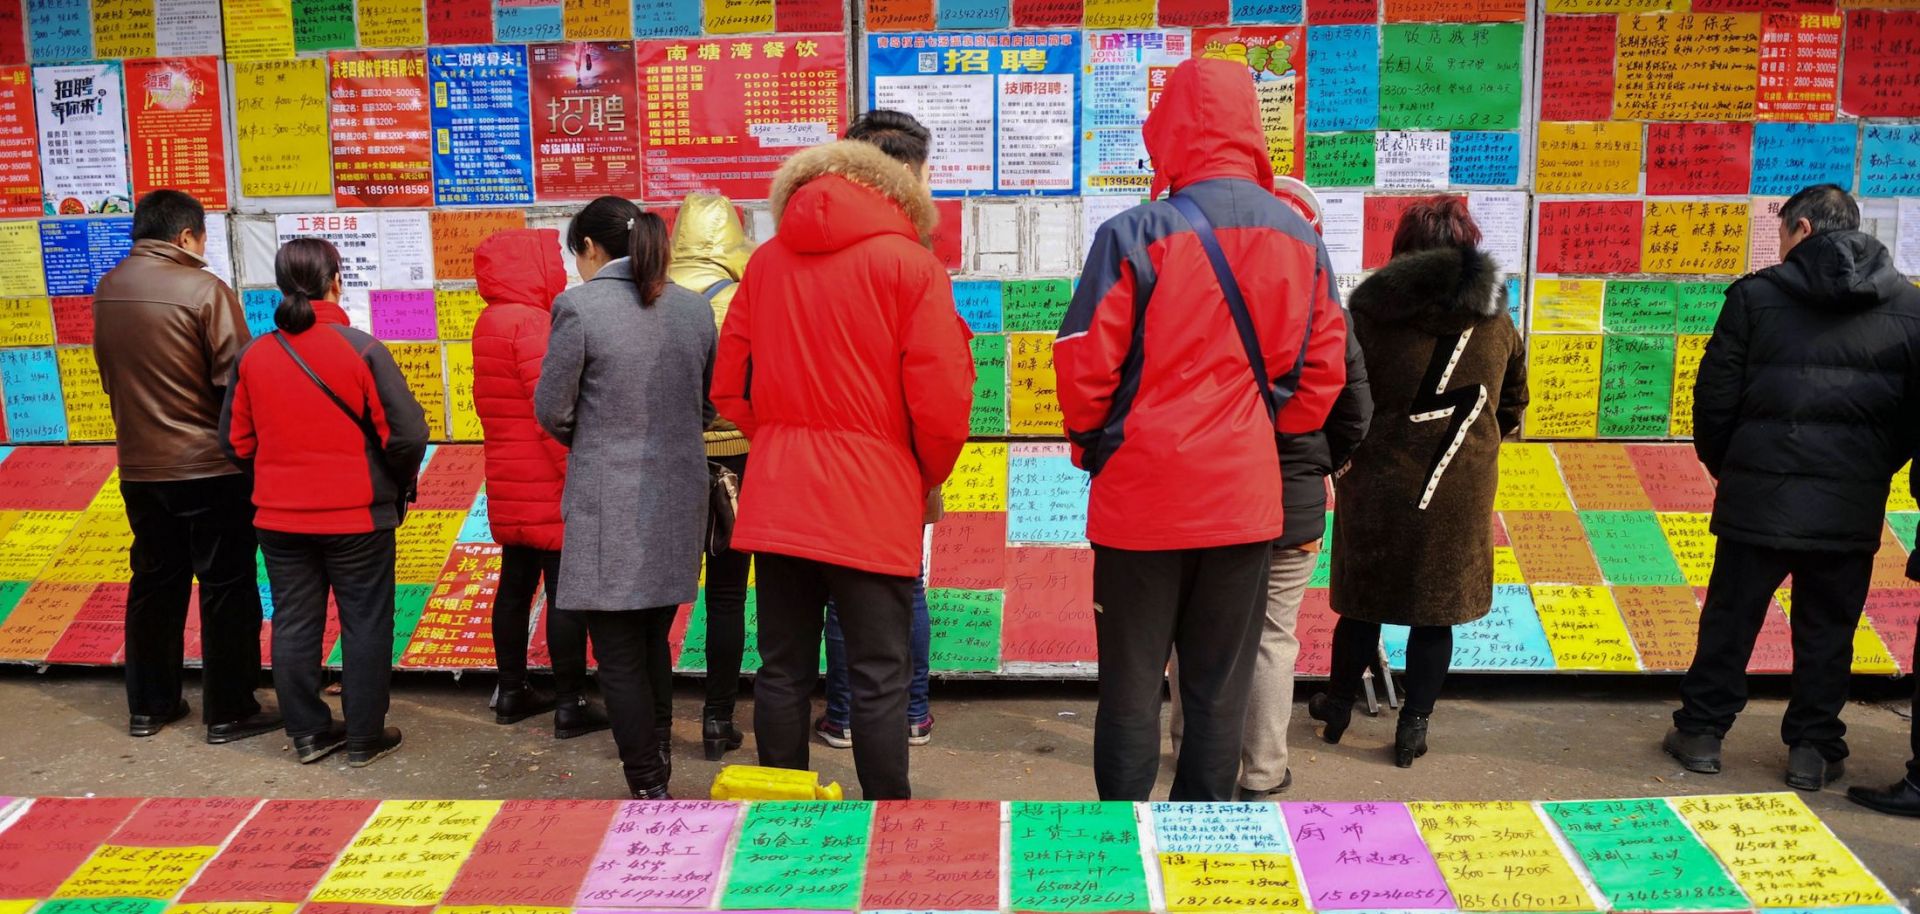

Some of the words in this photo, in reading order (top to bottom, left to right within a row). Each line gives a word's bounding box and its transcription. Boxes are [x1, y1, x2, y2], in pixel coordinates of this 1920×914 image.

[1799, 14, 1842, 29] 招聘
[664, 40, 819, 61] 南塘湾餐饮
[943, 48, 1048, 73] 招聘
[55, 75, 96, 100] 招聘
[546, 94, 626, 136] 招聘
[1375, 138, 1449, 152] 洗衣店转让
[296, 215, 358, 231] 工资日结
[1295, 822, 1364, 843] 厨师
[1420, 816, 1478, 832] 服务员
